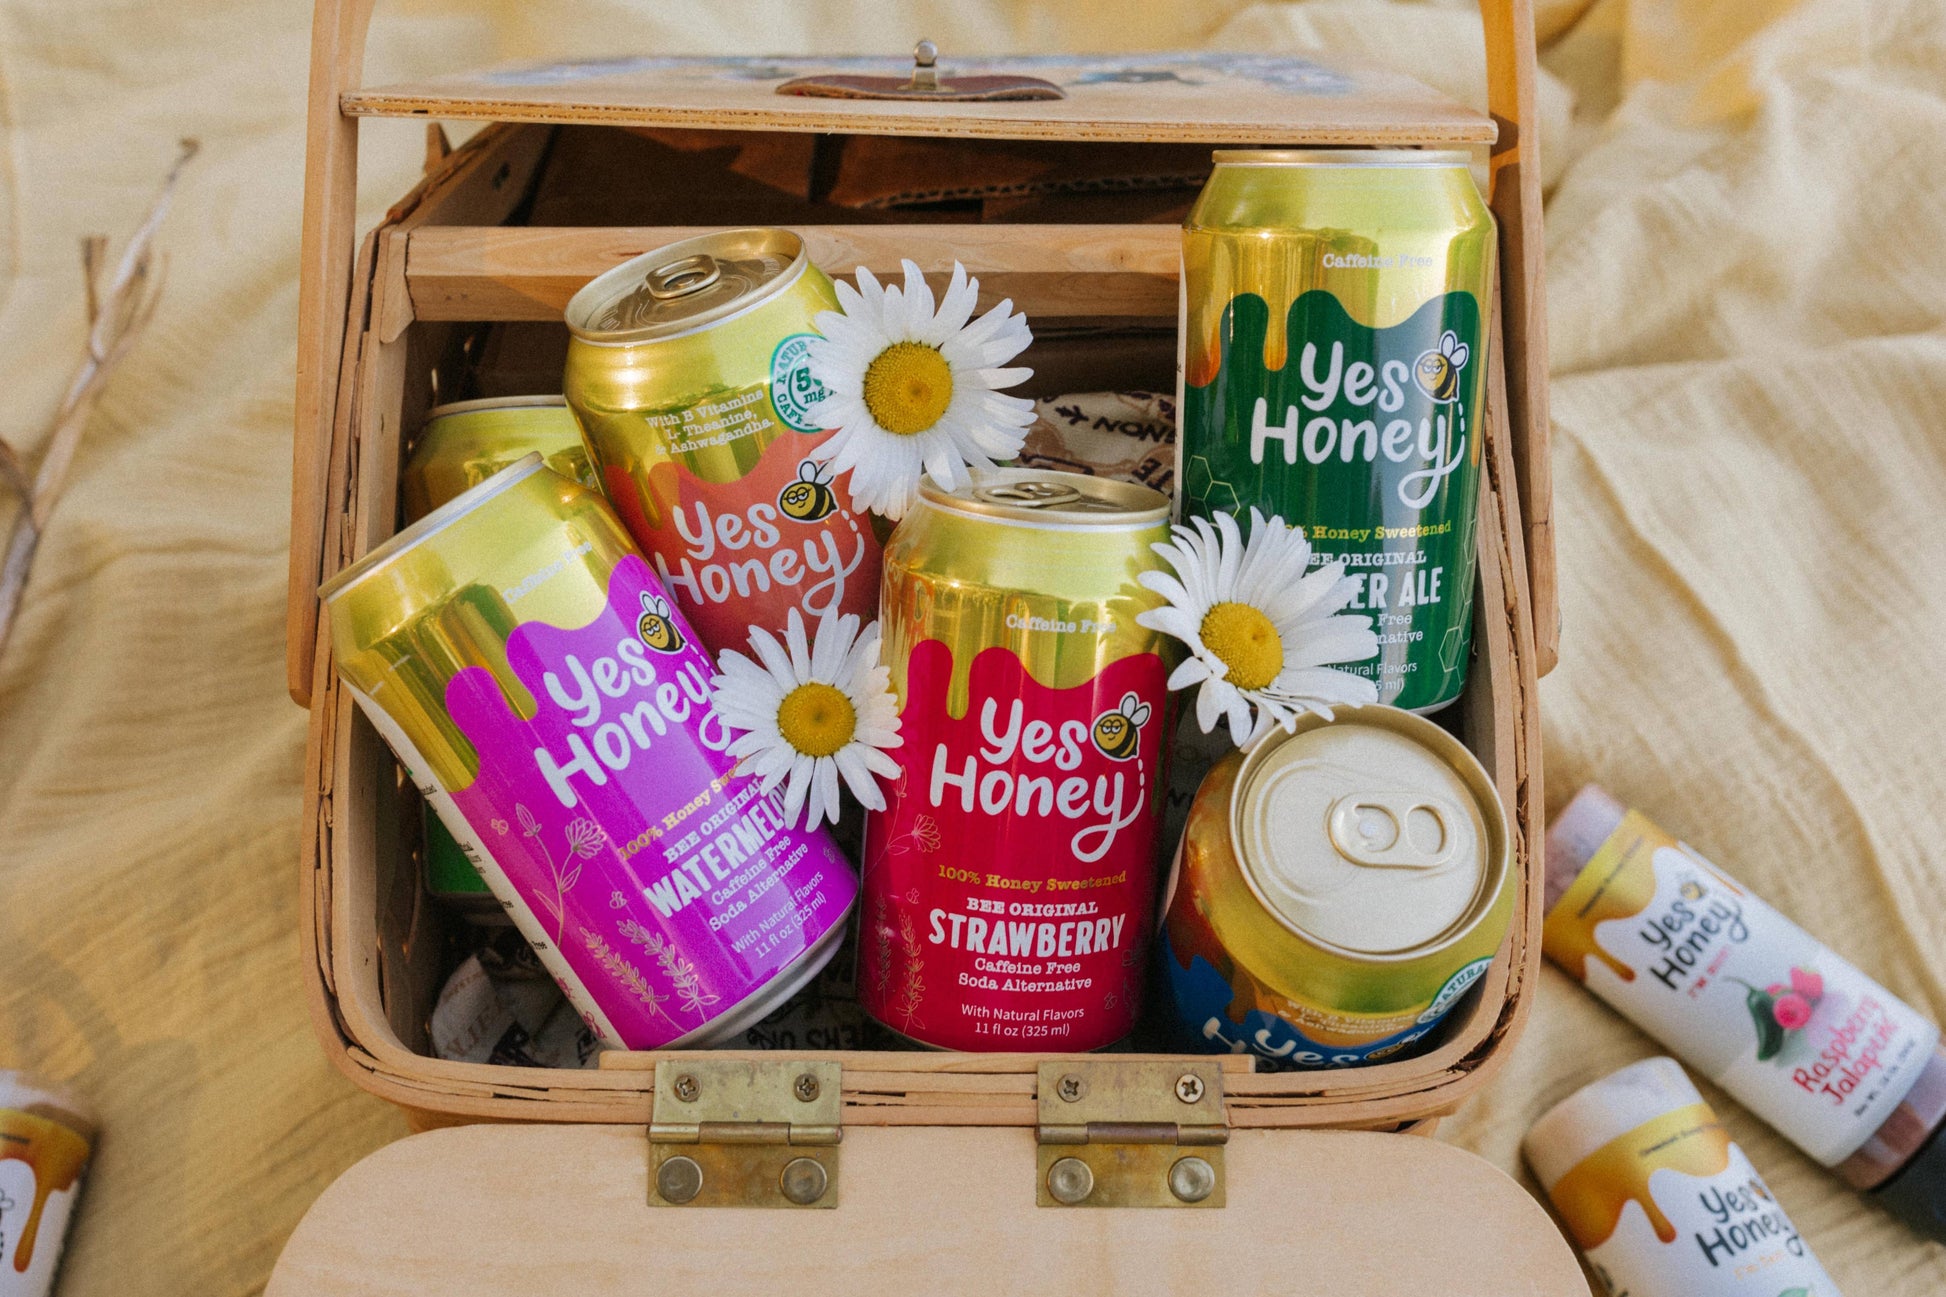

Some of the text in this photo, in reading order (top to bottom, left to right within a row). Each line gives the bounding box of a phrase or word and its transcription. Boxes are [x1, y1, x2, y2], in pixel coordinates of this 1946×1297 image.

[1323, 253, 1433, 268] Caffeine Free
[804, 389, 826, 404] mg
[1301, 341, 1409, 412] Yes
[645, 389, 764, 429] With B Vitamins
[683, 409, 757, 437] Theanine,
[655, 418, 775, 455] & Ashwagandha.
[1251, 397, 1465, 509] Honey
[673, 501, 779, 560] Yes
[1313, 526, 1372, 543] Honey
[1375, 520, 1452, 540] Sweetened
[655, 530, 865, 616] Honey
[1309, 550, 1427, 567] EE ORIGINAL
[1398, 567, 1443, 607] ALE
[1006, 614, 1117, 633] Caffeine Free
[1377, 613, 1412, 626] Free
[1377, 630, 1423, 645] native
[543, 638, 656, 727] Yes
[1377, 662, 1417, 675] Flavors
[534, 661, 731, 808] Honey
[980, 696, 1088, 771] Yes
[663, 778, 762, 864] BEE ORIGINAL
[929, 743, 1145, 863] Honey
[618, 789, 711, 860] 100% Honey
[708, 843, 809, 932] Soda Alternative
[712, 835, 792, 906] Caffeine Free
[938, 864, 1126, 894] 100% Honey Sweetened
[731, 871, 824, 953] With Natural Flavors
[755, 890, 827, 958] 11 fl oz (325 ml)
[966, 897, 1098, 917] BEE ORIGINAL
[1640, 901, 1695, 951] Yes
[928, 908, 1126, 958] STRAWBERRY
[1649, 901, 1749, 990] Honey
[958, 973, 1092, 993] Soda Alternative
[975, 957, 1081, 975] Caffeine Free
[961, 1003, 1085, 1021] With Natural Flavors
[974, 1022, 1070, 1038] 11 fl oz (325 ml)
[1699, 1185, 1758, 1224] Yes
